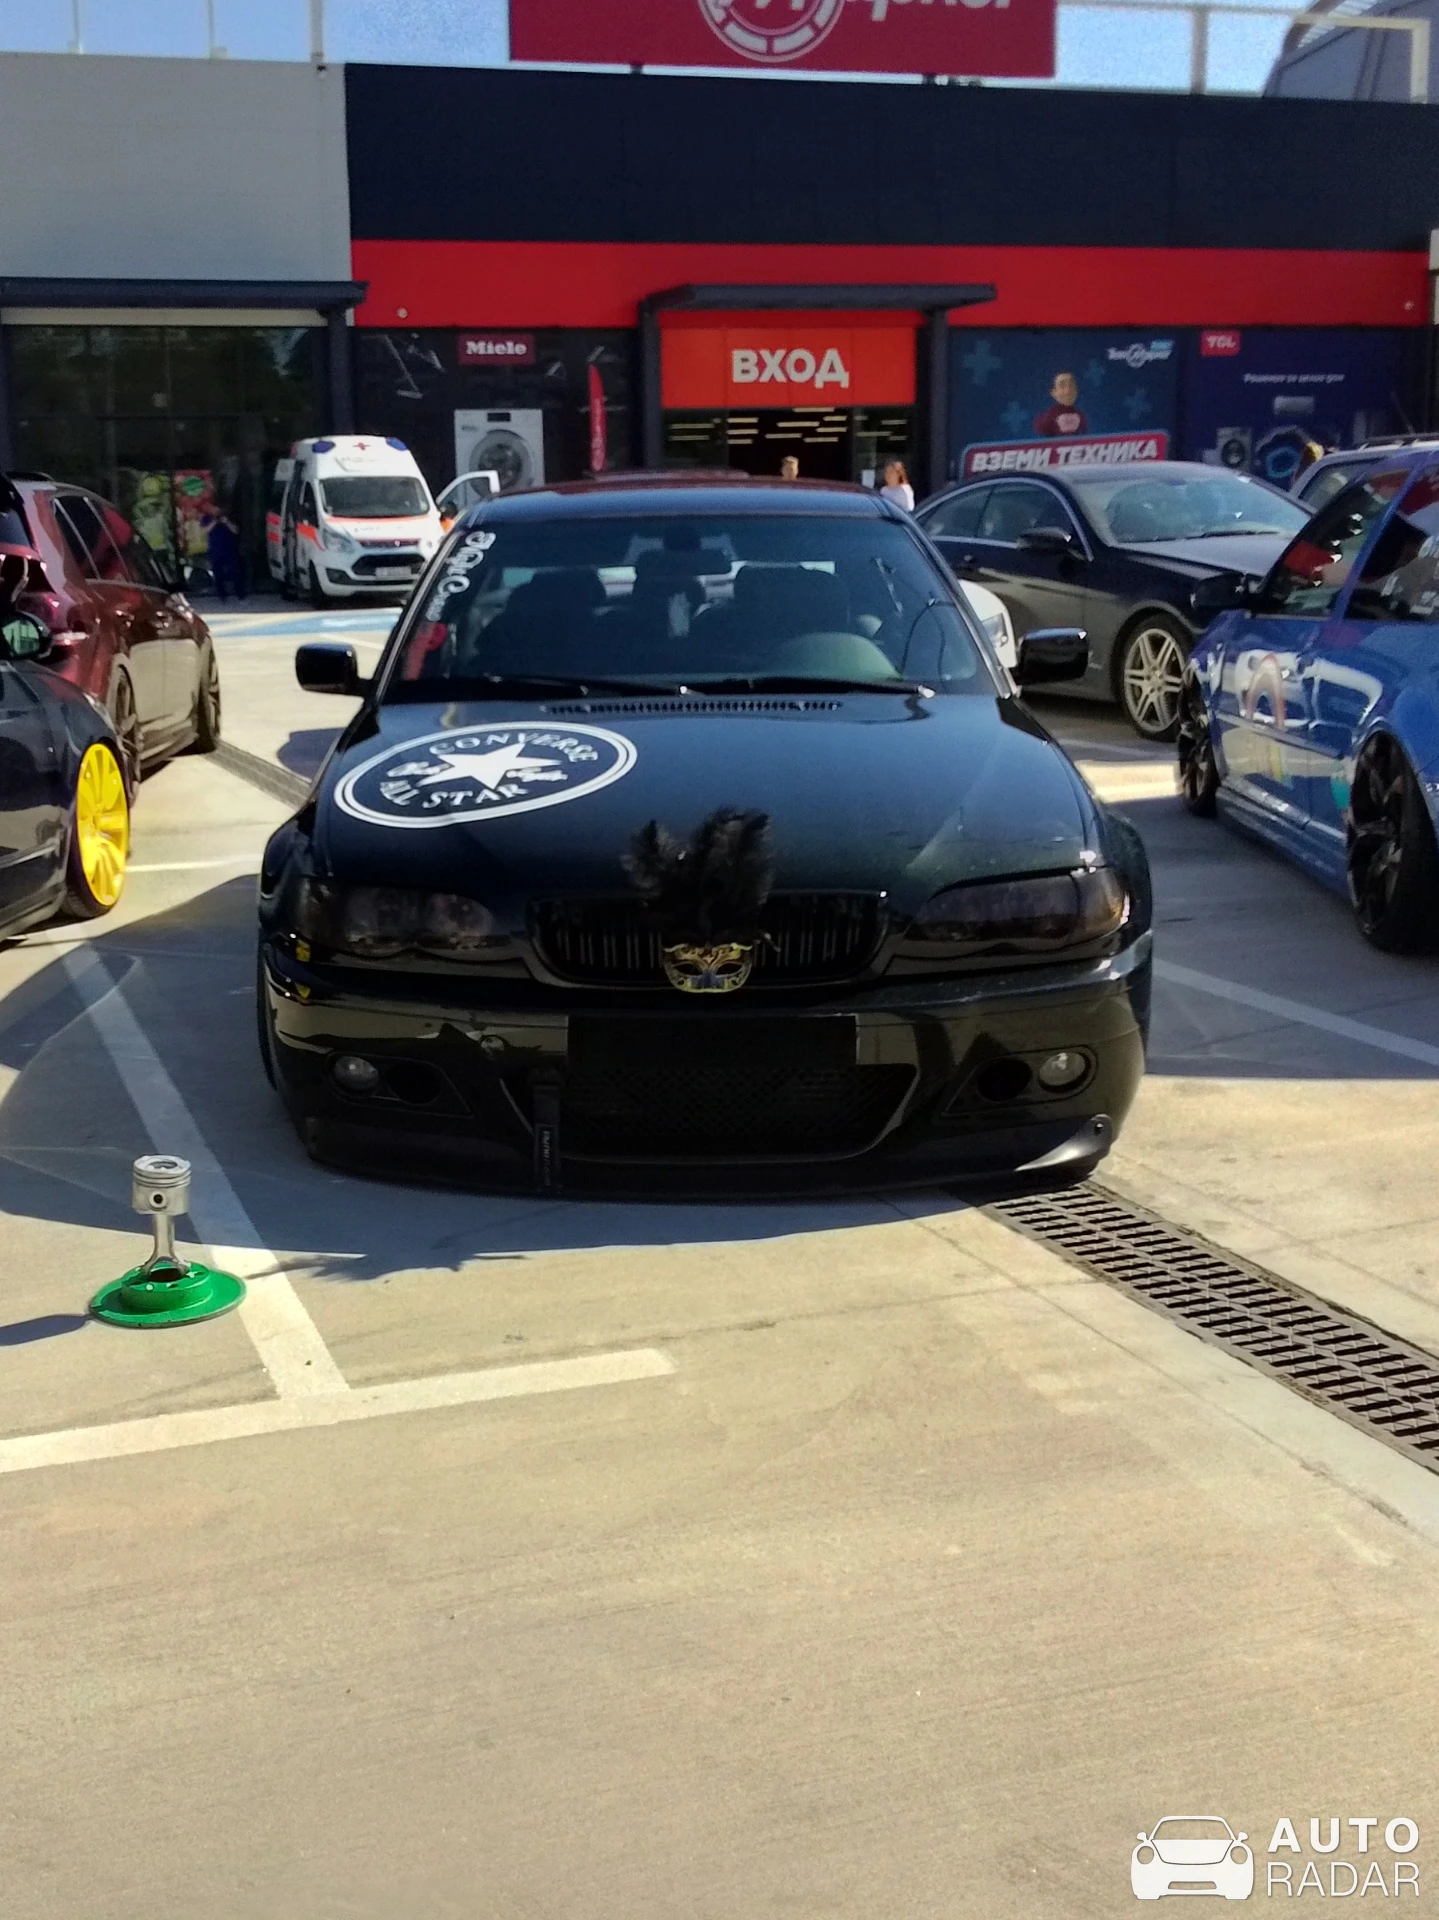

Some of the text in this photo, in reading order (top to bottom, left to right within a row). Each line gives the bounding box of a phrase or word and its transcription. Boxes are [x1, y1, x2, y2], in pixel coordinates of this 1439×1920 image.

[466, 341, 527, 355] Miele
[1206, 335, 1237, 349] TCL
[732, 348, 849, 389] ВХОД
[971, 439, 1158, 473] ВЗЕМИ ТЕХНИКА
[429, 732, 599, 763] CONVERSE
[422, 782, 529, 809] STAR
